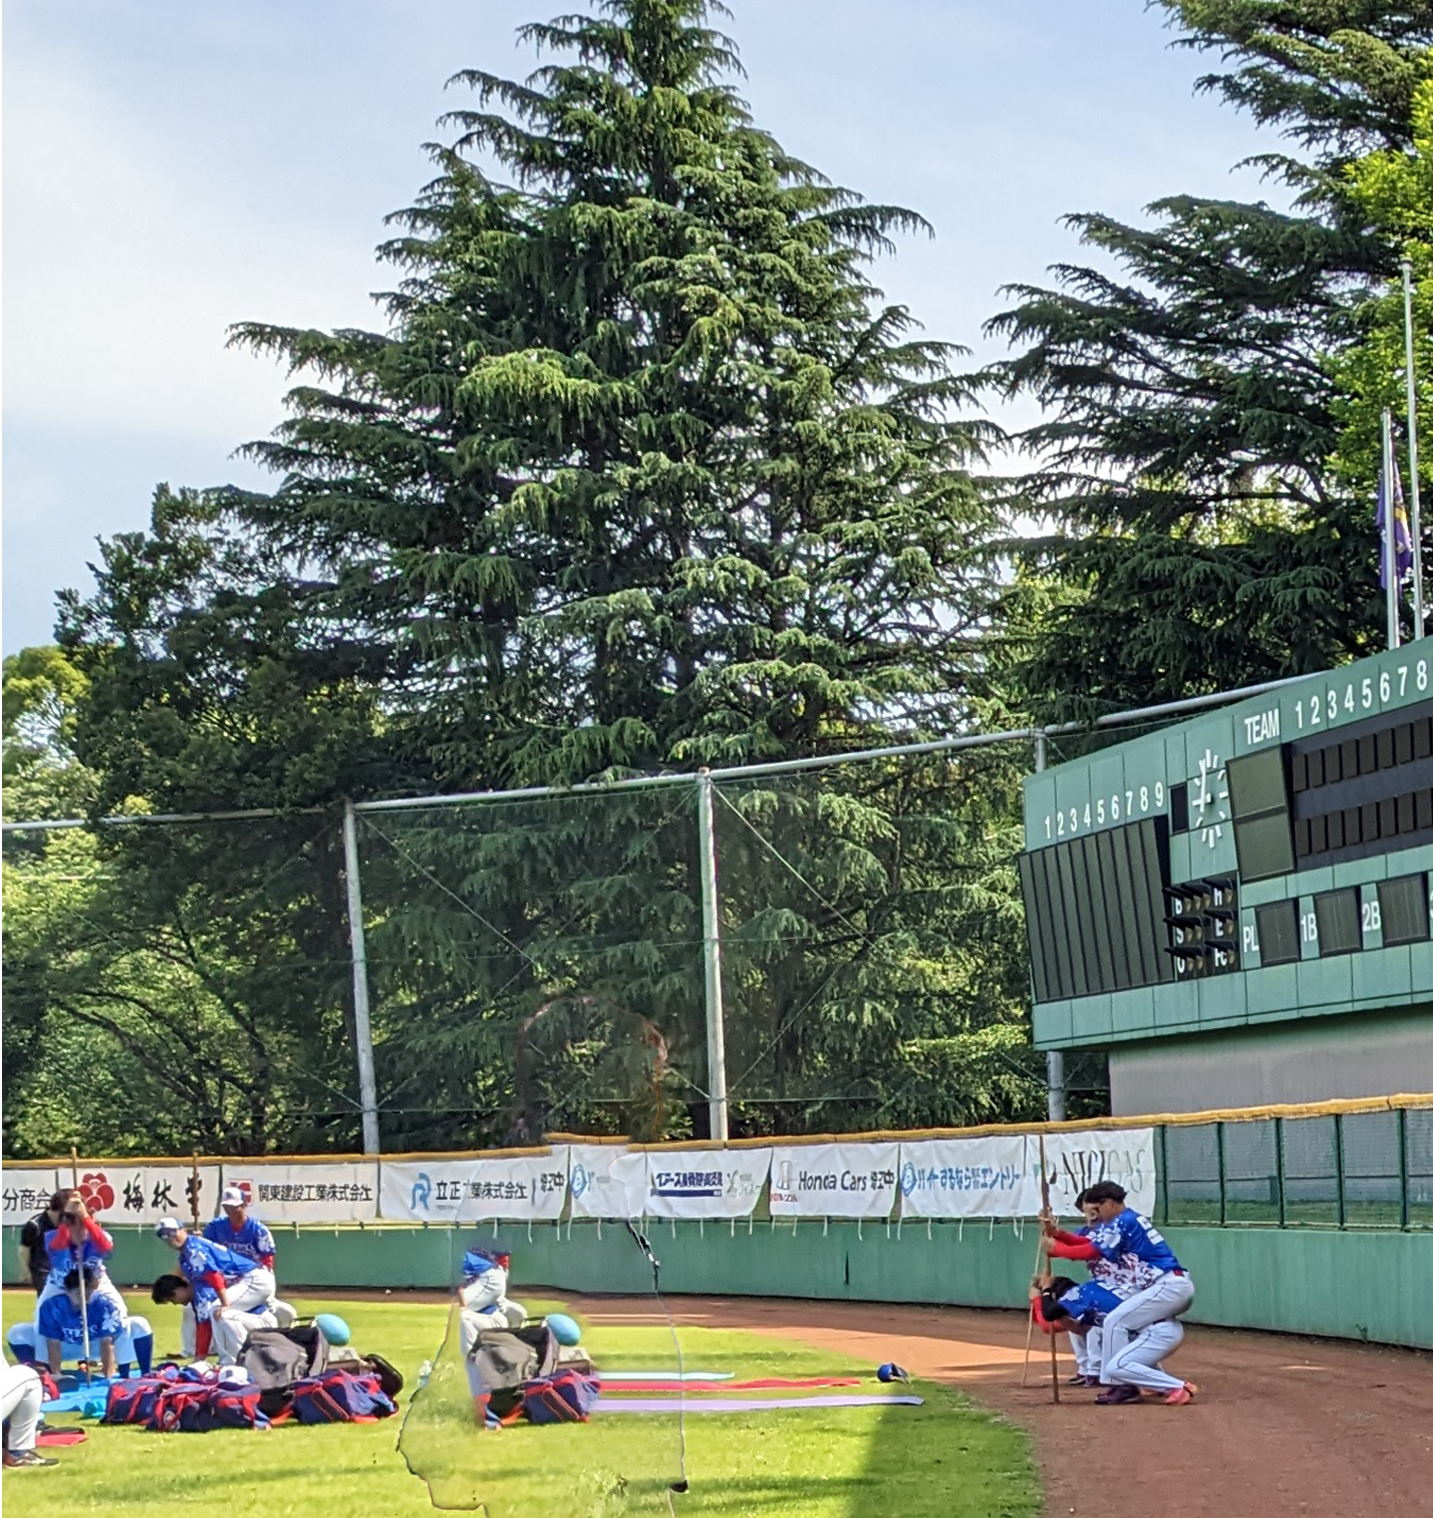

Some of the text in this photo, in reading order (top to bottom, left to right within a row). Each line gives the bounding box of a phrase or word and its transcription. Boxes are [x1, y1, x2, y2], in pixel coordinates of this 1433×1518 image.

[1244, 708, 1280, 745] TEAM
[1295, 700, 1303, 728] 1
[1310, 695, 1320, 725] 2
[1327, 690, 1337, 719] 3
[1344, 684, 1354, 713] 4
[1362, 678, 1372, 708] 5
[1379, 672, 1390, 702] 6
[1397, 666, 1408, 696] 7
[1416, 660, 1427, 691] 8
[1044, 781, 1164, 839] 1 2 3 4 5 6 7 8 9
[1301, 912, 1318, 942] 1B
[1362, 901, 1382, 932] 2B
[1243, 925, 1259, 953] PL
[841, 1170, 867, 1191] Cars
